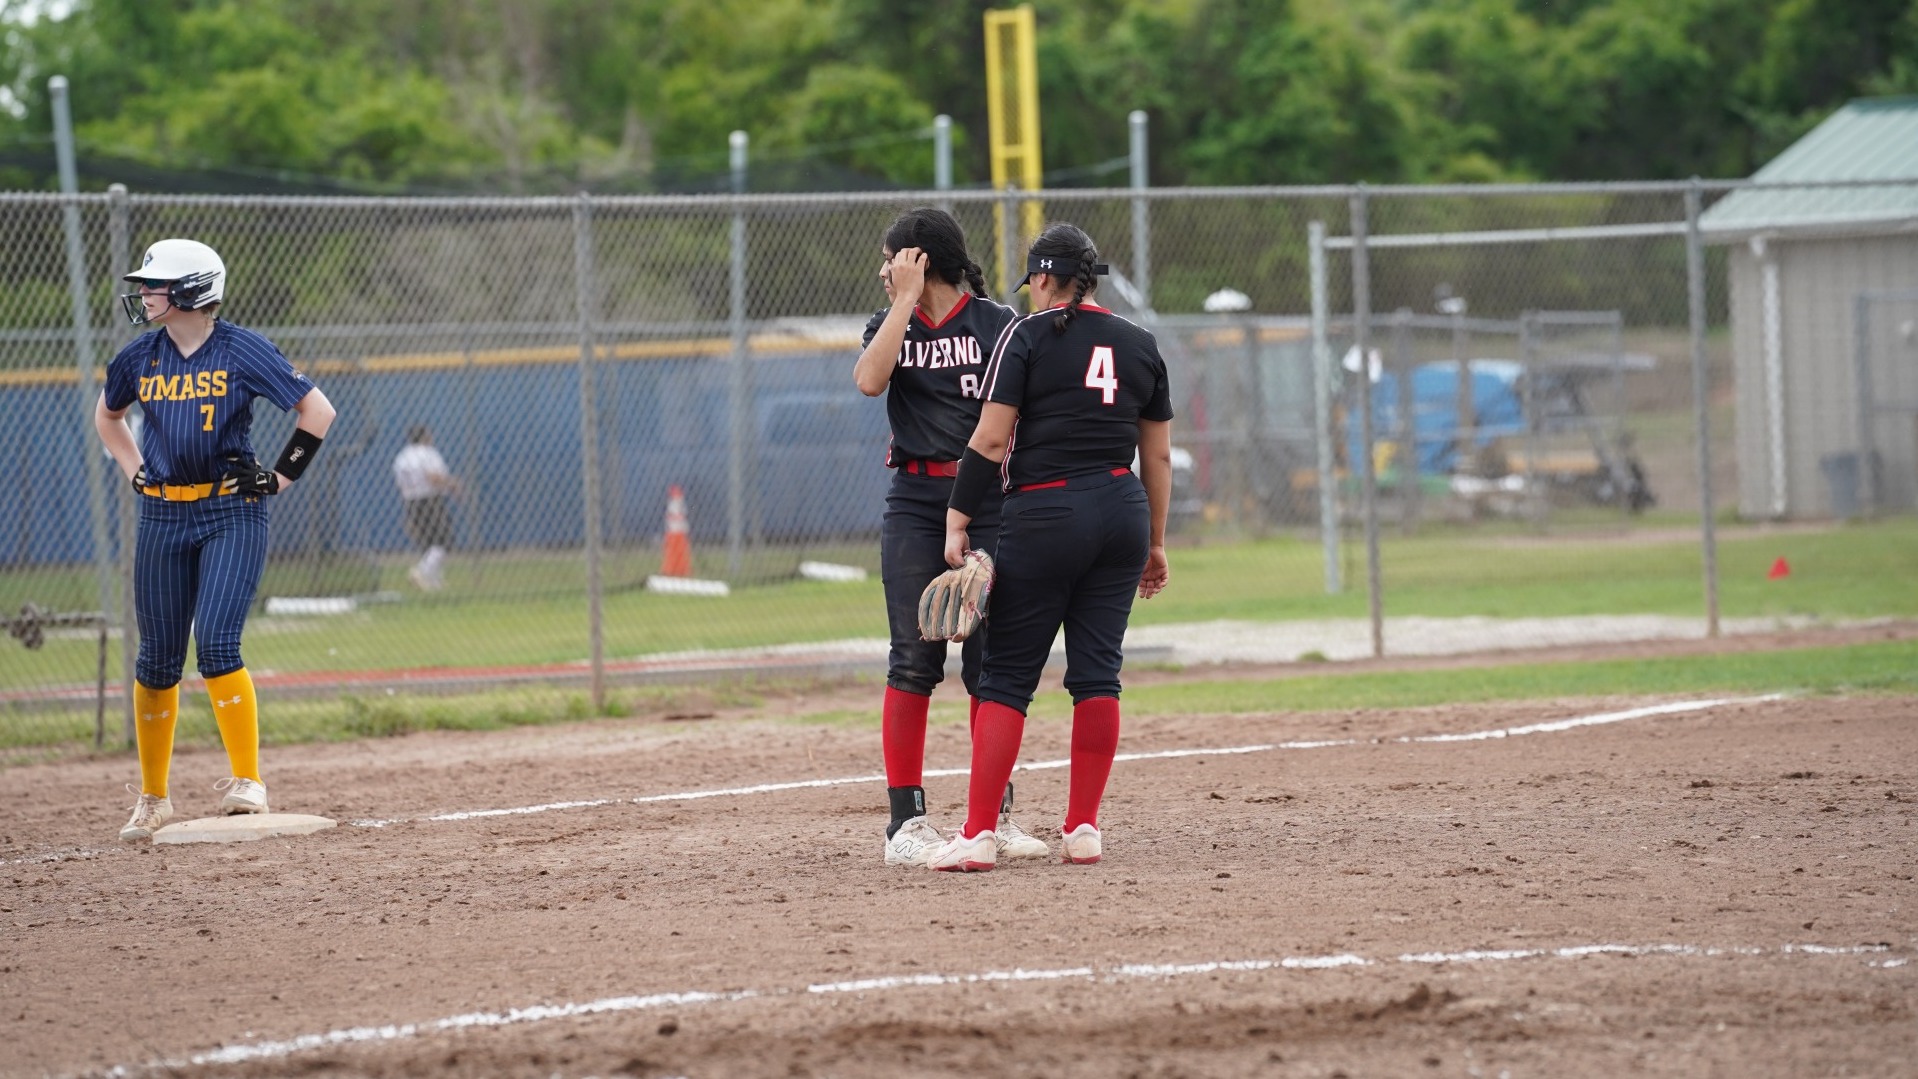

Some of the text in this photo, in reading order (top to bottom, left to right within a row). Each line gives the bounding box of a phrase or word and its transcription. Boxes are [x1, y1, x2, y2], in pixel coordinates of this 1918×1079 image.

[898, 336, 982, 369] LVERNO
[139, 370, 227, 402] UMASS
[960, 373, 979, 398] 8
[1083, 345, 1119, 405] 4
[200, 404, 214, 431] 7
